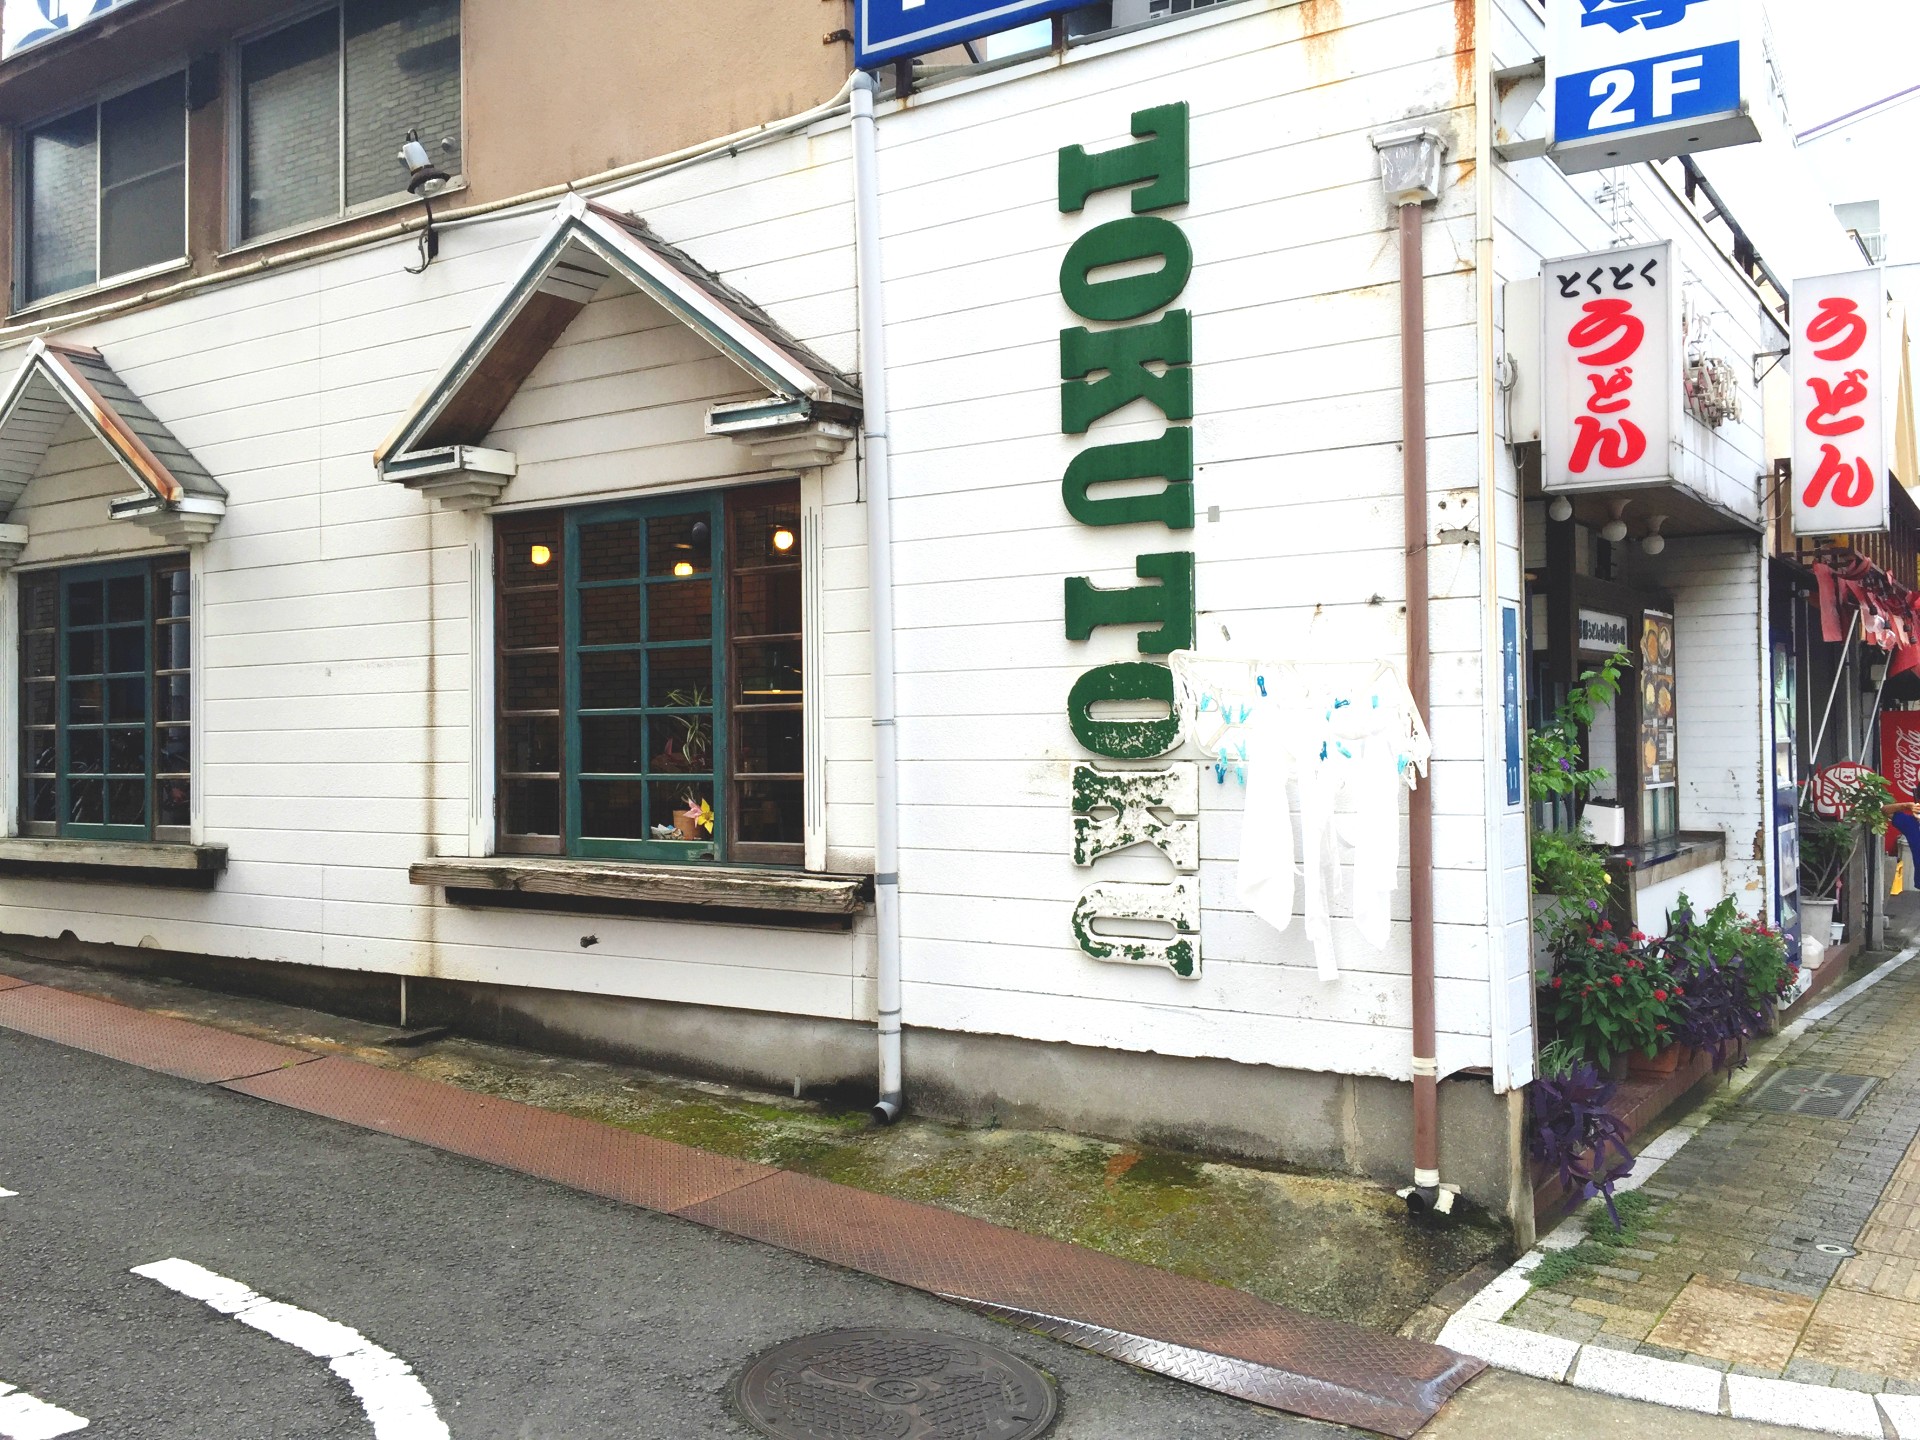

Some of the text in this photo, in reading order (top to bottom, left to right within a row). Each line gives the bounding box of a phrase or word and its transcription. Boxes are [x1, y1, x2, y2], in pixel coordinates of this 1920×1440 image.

[1587, 54, 1703, 131] 2F
[1556, 258, 1659, 298] とくとく
[1567, 298, 1647, 474] うどん
[1802, 297, 1875, 508] うどん
